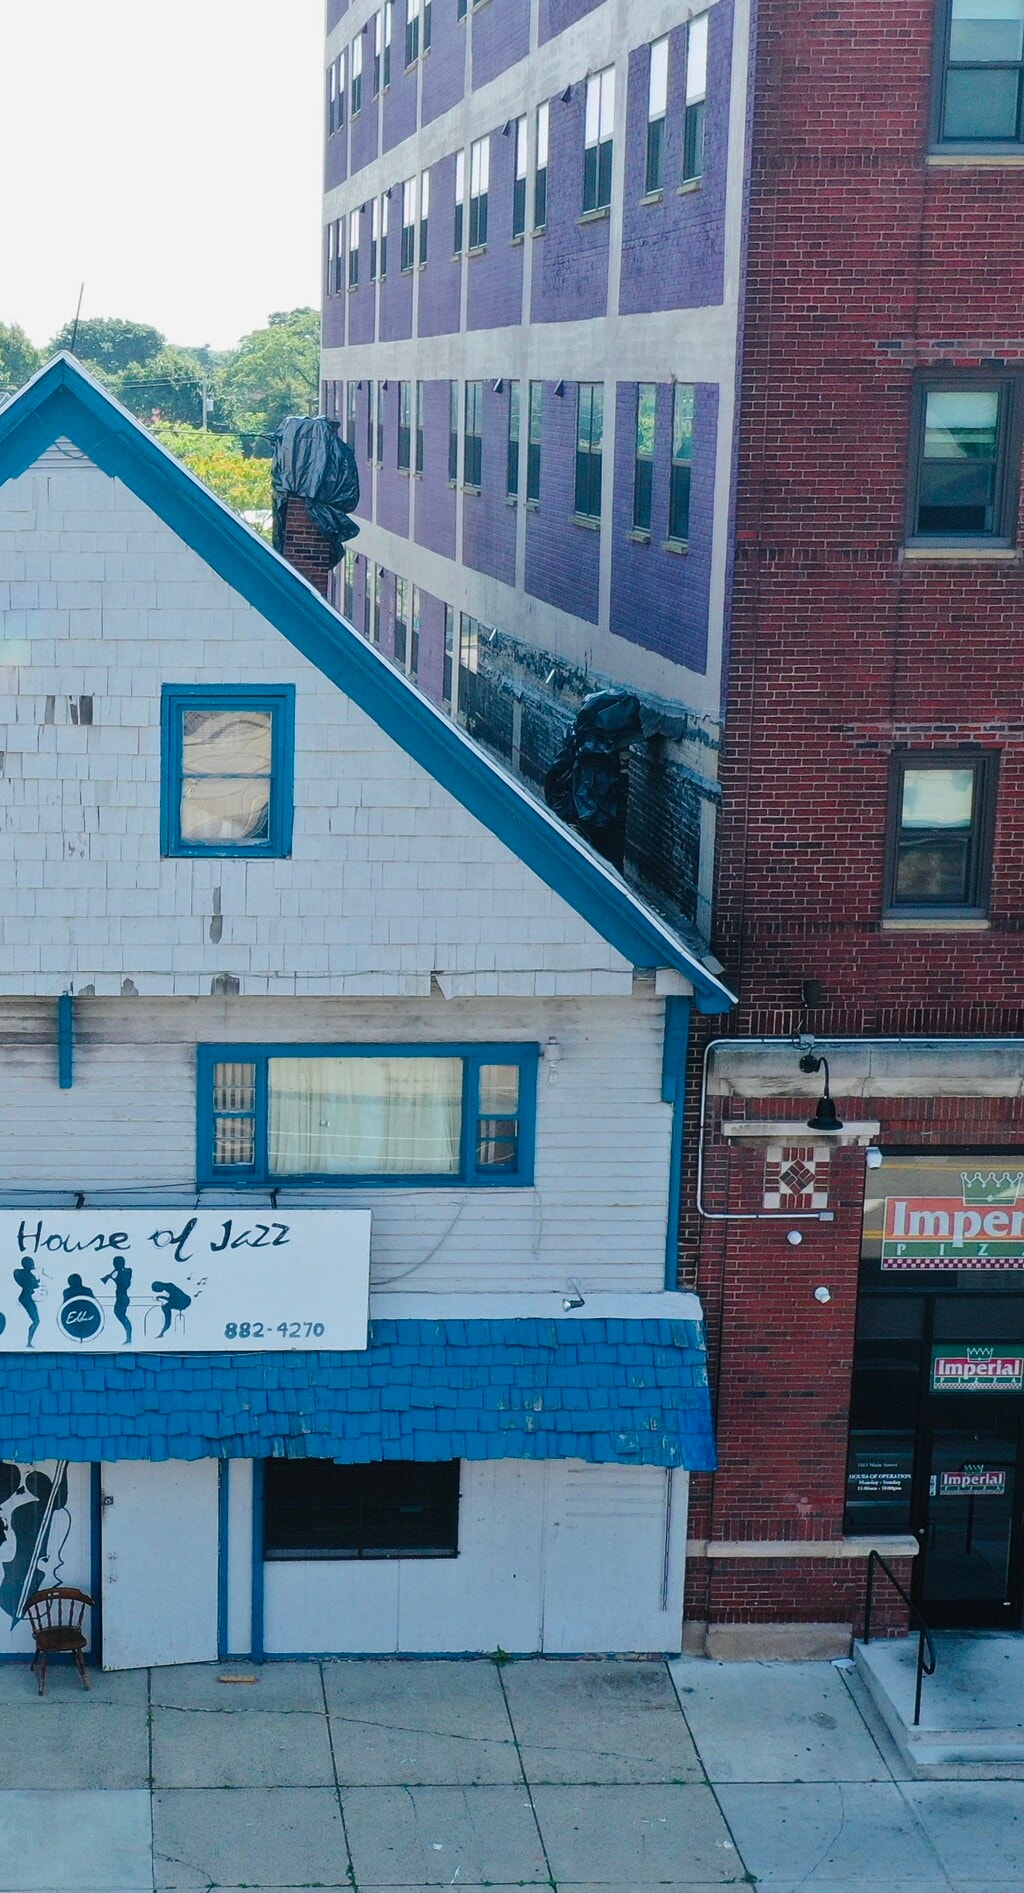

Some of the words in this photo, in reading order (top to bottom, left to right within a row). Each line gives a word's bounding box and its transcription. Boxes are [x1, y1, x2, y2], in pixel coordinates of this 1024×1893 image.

[17, 1220, 131, 1253] House
[146, 1217, 198, 1262] of
[210, 1219, 290, 1252] Jazz
[896, 1243, 1024, 1256] PIZ
[224, 1322, 325, 1340] 882-4270
[938, 1360, 1020, 1380] Imperial
[943, 1473, 1003, 1488] Imperial
